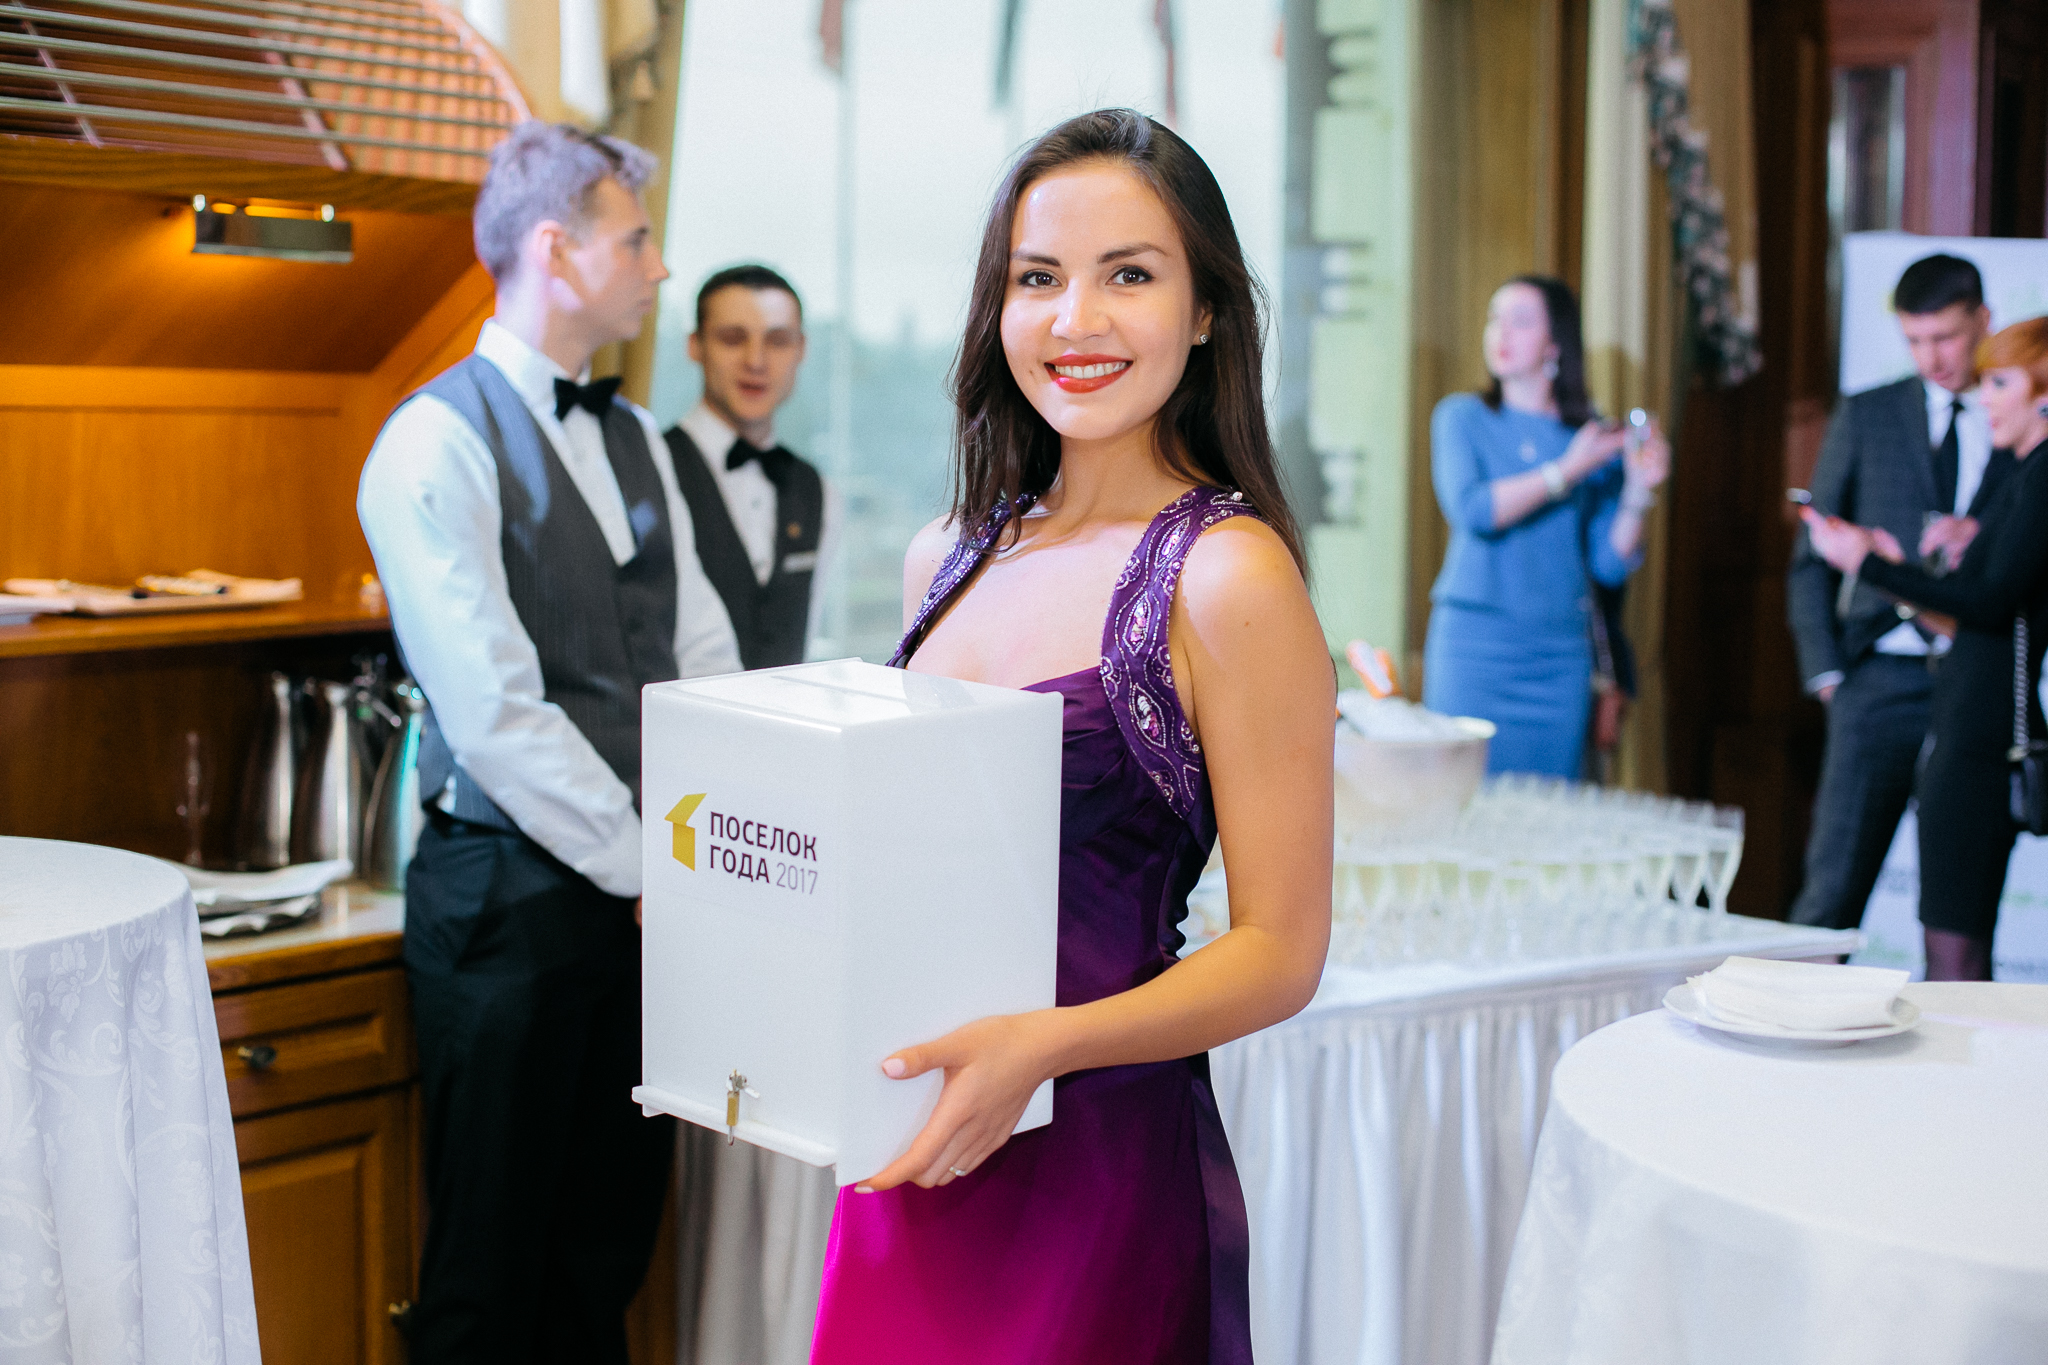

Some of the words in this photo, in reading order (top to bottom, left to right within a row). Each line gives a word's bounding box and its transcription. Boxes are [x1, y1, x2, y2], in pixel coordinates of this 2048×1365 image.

[710, 811, 817, 862] ПОСЕЛОК
[710, 844, 770, 884] ГОДА
[776, 862, 818, 895] 2017
